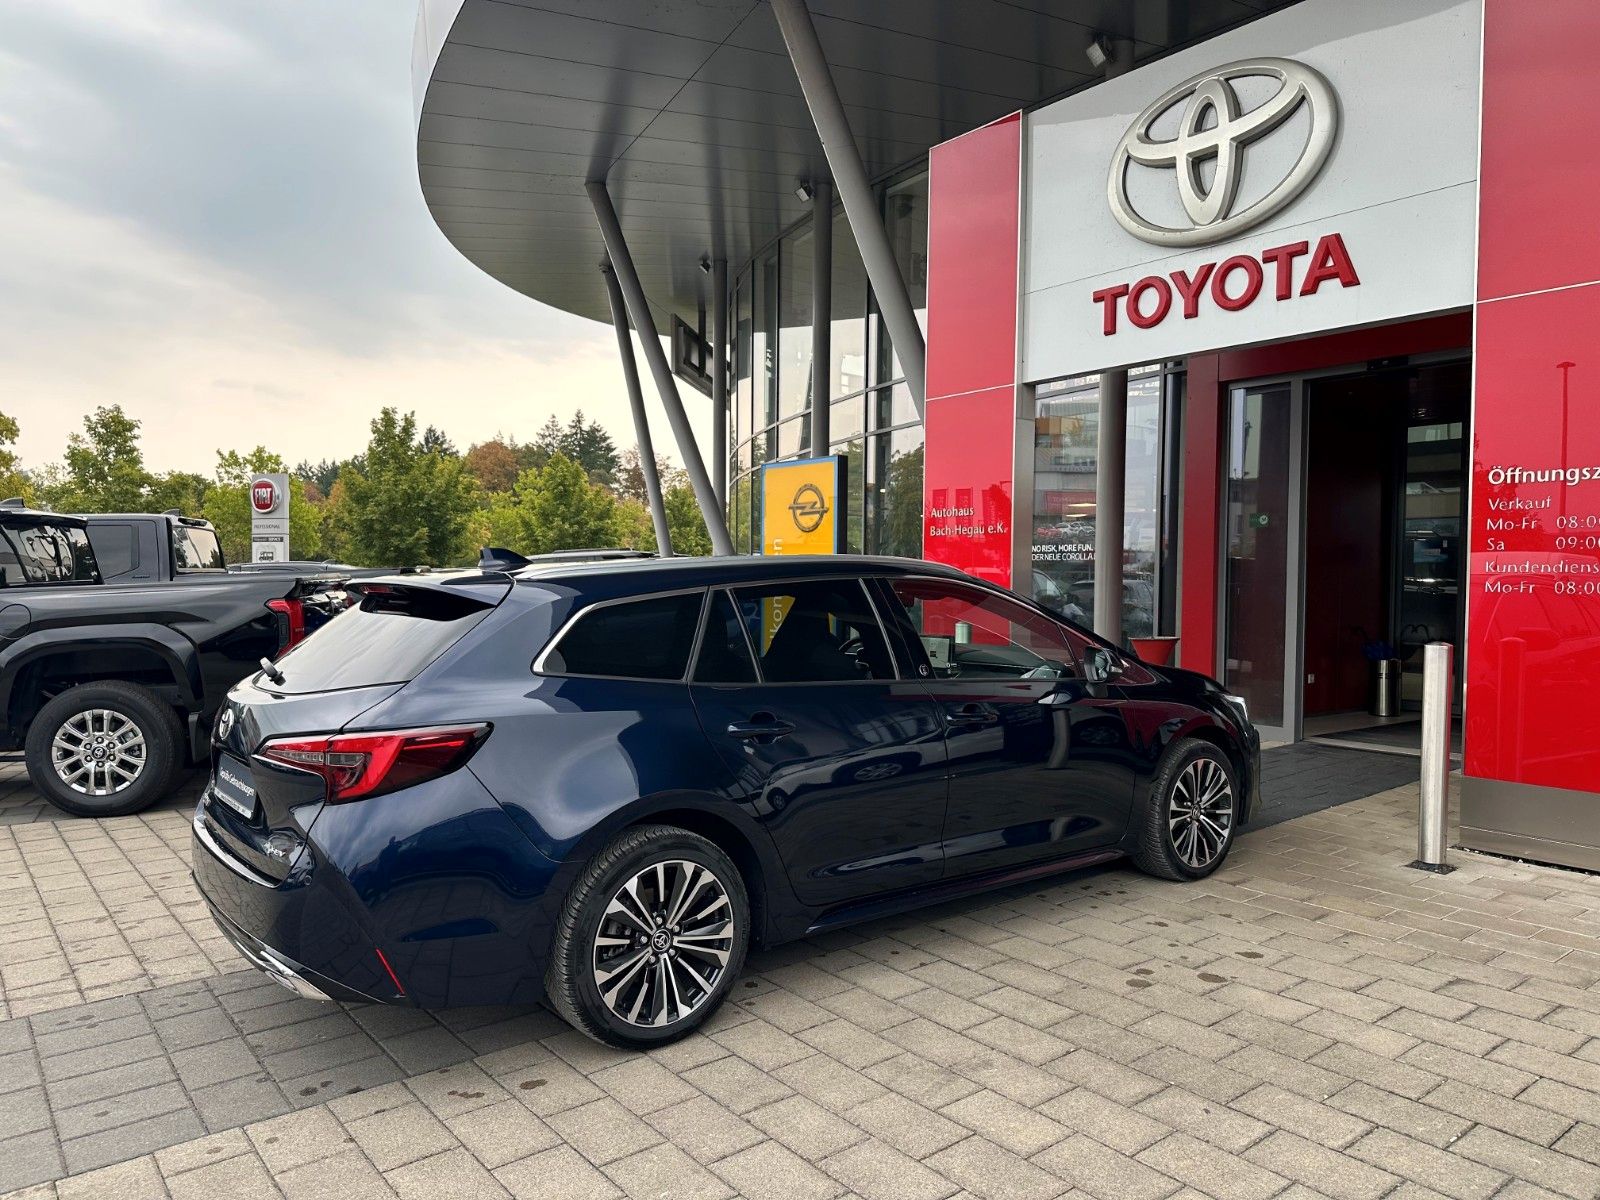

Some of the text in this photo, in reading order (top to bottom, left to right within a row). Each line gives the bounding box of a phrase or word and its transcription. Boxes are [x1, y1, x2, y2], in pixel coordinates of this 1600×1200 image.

[1093, 233, 1360, 336] TOYOTA
[1488, 465, 1600, 486] Öffnungsz
[255, 487, 272, 505] FIAT
[1488, 496, 1551, 511] Verkauf
[931, 506, 974, 518] Autohaus
[929, 522, 1006, 538] Bach-Hegau e.K.
[1486, 515, 1600, 531] Mo-Fr 08:0
[1041, 544, 1058, 553] RISK,
[1058, 544, 1077, 552] MORE
[1077, 543, 1093, 551] FUN.
[1486, 536, 1600, 551] Sa 09:0
[1032, 553, 1044, 561] DER
[1061, 552, 1093, 560] COROLLA
[1485, 559, 1599, 574] Kundendiens
[1484, 580, 1535, 594] Mo-Fr
